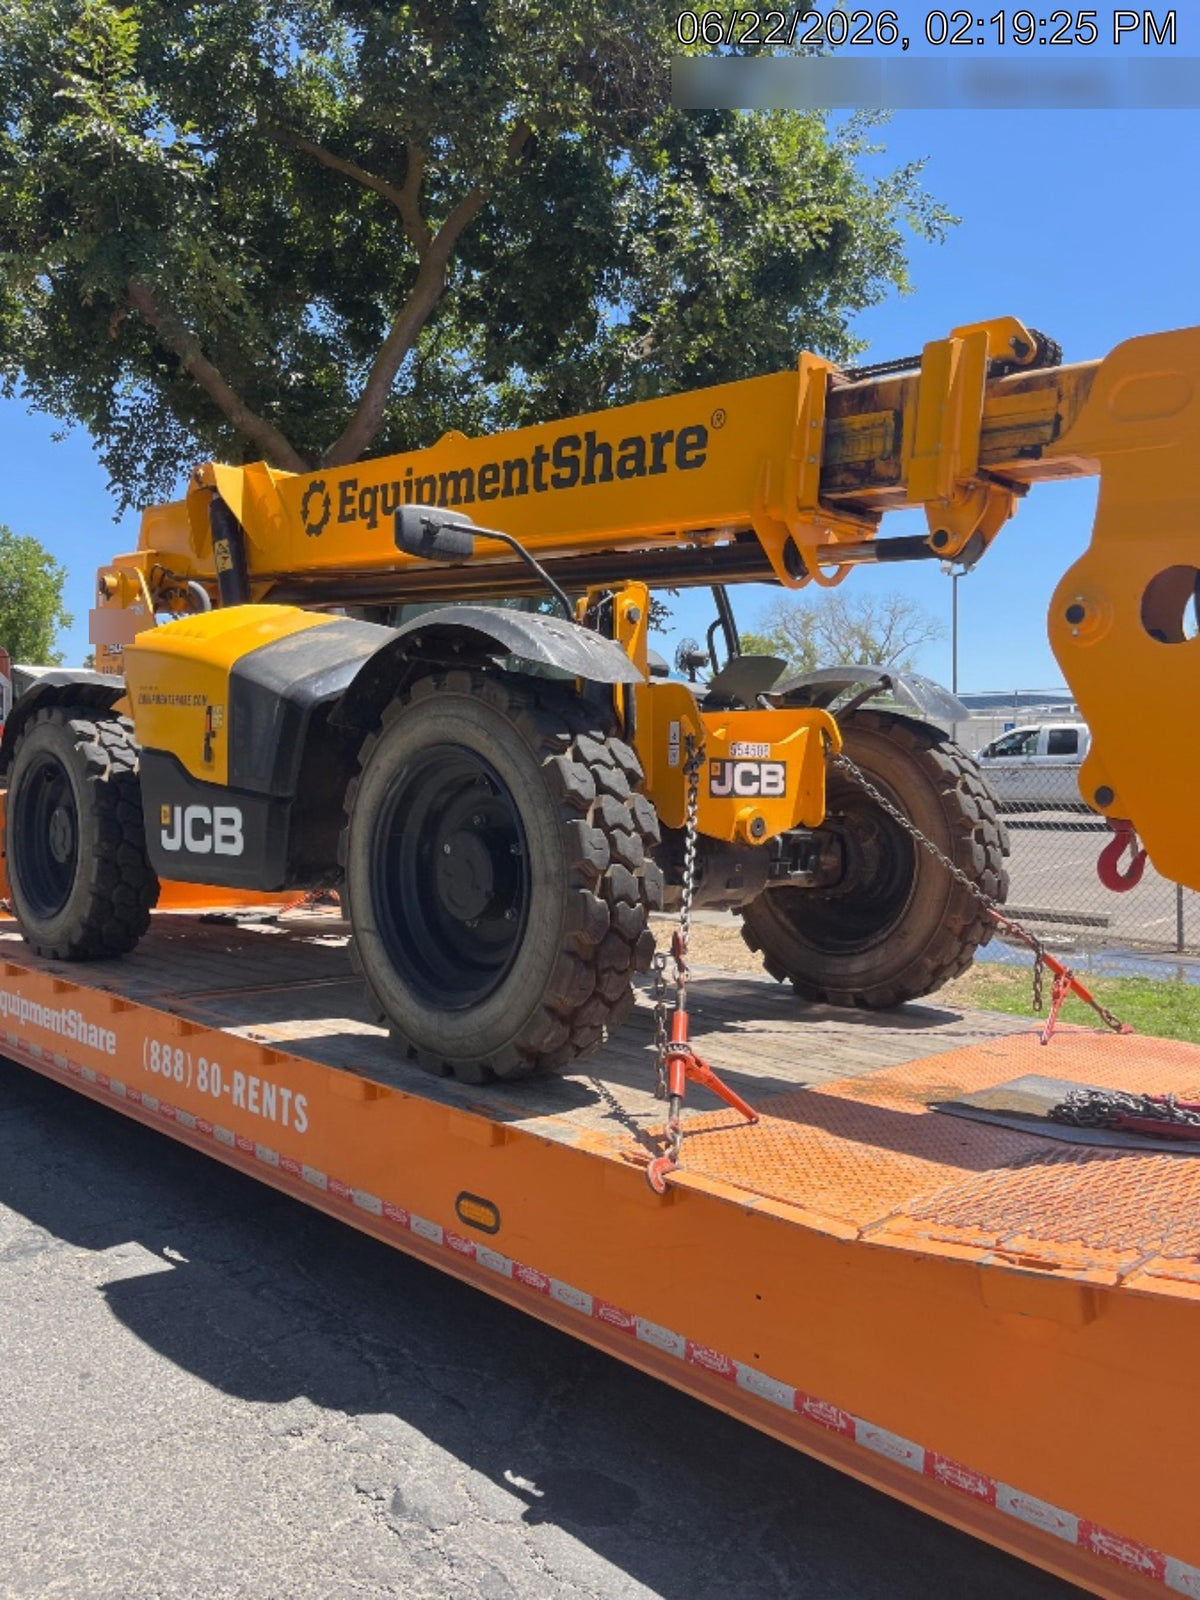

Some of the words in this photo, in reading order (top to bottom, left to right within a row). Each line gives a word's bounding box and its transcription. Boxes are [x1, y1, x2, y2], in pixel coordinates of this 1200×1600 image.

[711, 761, 785, 796] JCB
[160, 805, 244, 856] JCB
[0, 990, 117, 1055] quipmentShare
[142, 1036, 192, 1088] (888)
[197, 1057, 309, 1133] 80-RENTS
